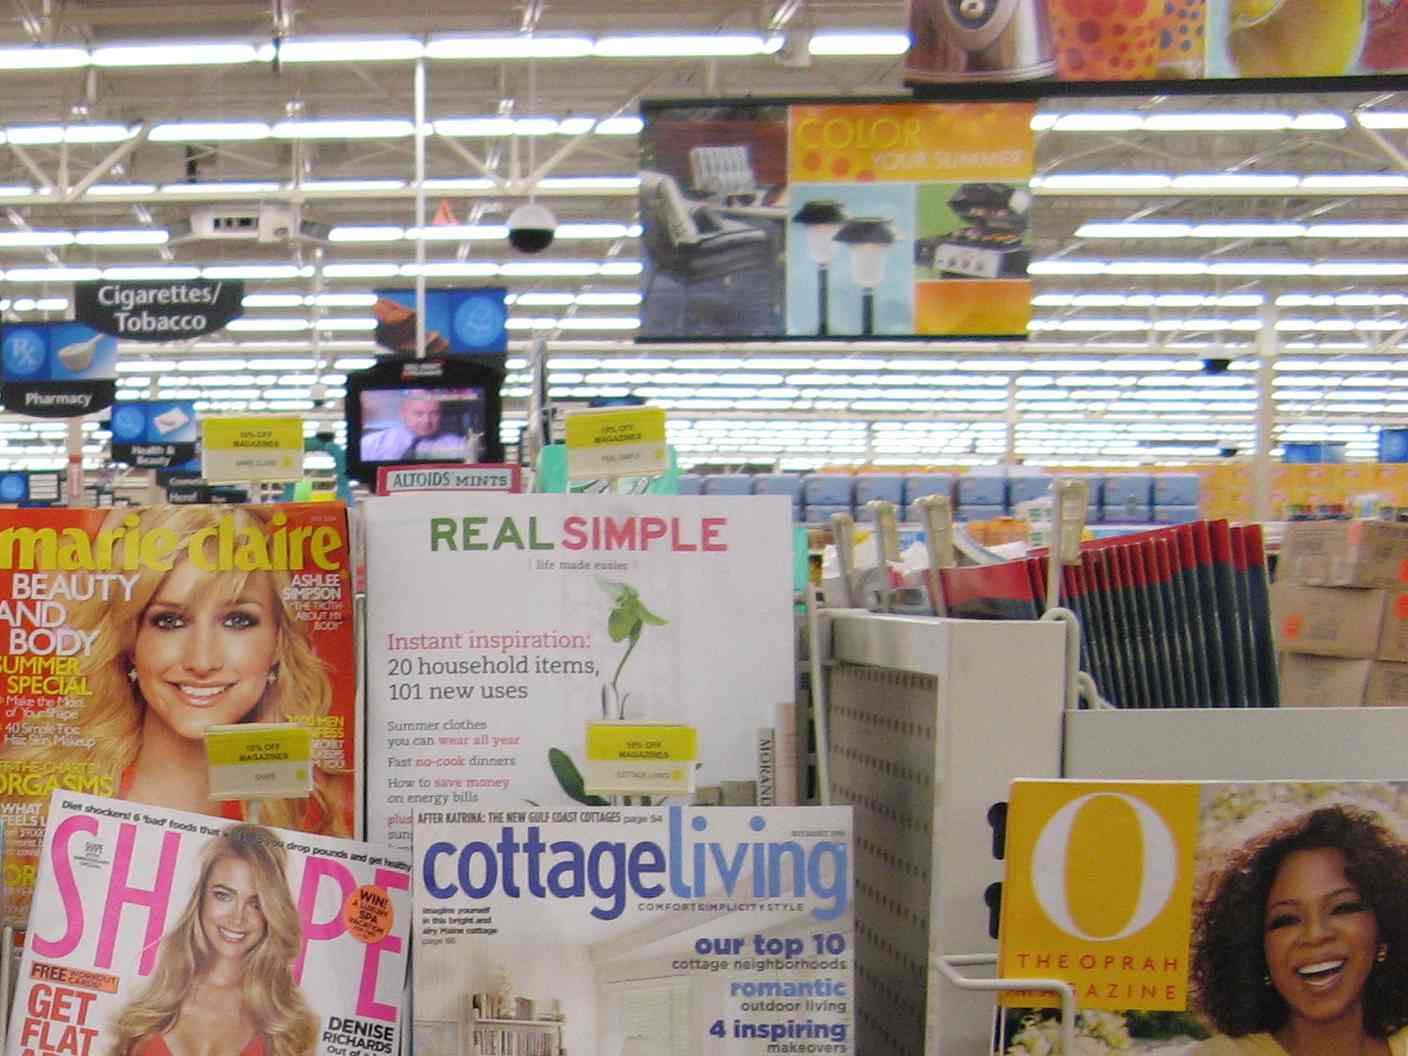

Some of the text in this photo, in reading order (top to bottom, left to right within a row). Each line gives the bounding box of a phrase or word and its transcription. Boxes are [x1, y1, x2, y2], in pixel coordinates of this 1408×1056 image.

[796, 117, 922, 148] COLOR
[98, 282, 222, 310] Cigarettes/
[115, 313, 207, 332] Tobacco
[25, 392, 92, 406] Pharmacy
[392, 471, 507, 488] ALTOIDS MINTS
[188, 513, 342, 570] claire
[431, 517, 727, 551] REAL SIMPLE
[13, 575, 141, 600] BEAUTY
[10, 629, 97, 656] BODY
[387, 631, 591, 654] Instant inspiration:
[387, 656, 600, 678] 20 household items,
[696, 934, 846, 958] our top 10
[731, 980, 846, 998] romantic
[28, 984, 97, 1025] GET
[20, 1018, 97, 1056] FLAT
[328, 1017, 393, 1040] DENISE
[710, 1021, 846, 1043] 4 inspiring
[323, 1033, 392, 1053] RICHARDS
[767, 1043, 846, 1054] makeovers
